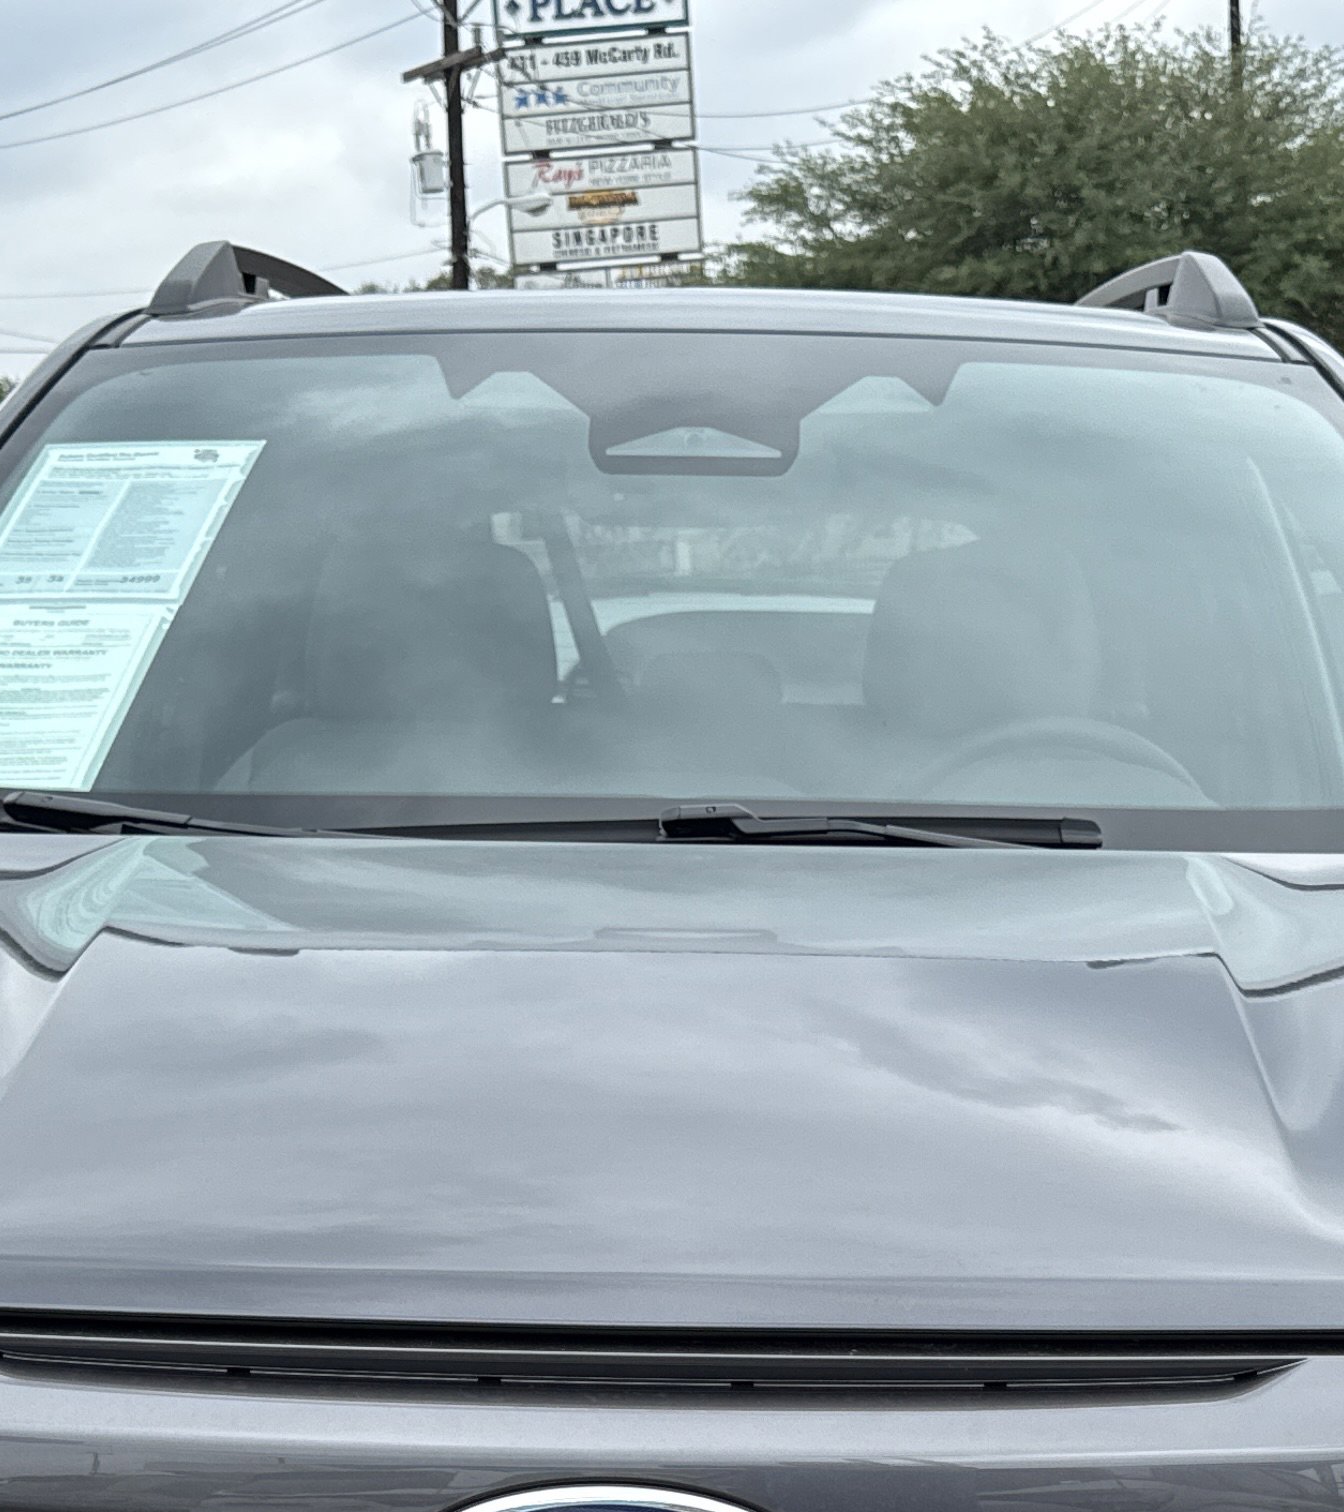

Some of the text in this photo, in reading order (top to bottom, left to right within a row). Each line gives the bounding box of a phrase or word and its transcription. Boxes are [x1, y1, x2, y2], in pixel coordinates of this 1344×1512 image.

[586, 46, 650, 65] McCarty
[653, 42, 681, 59] Rd.
[576, 75, 681, 97] Community
[552, 224, 659, 249] SINGAPORE
[13, 619, 91, 627] BUYERS GUIDE
